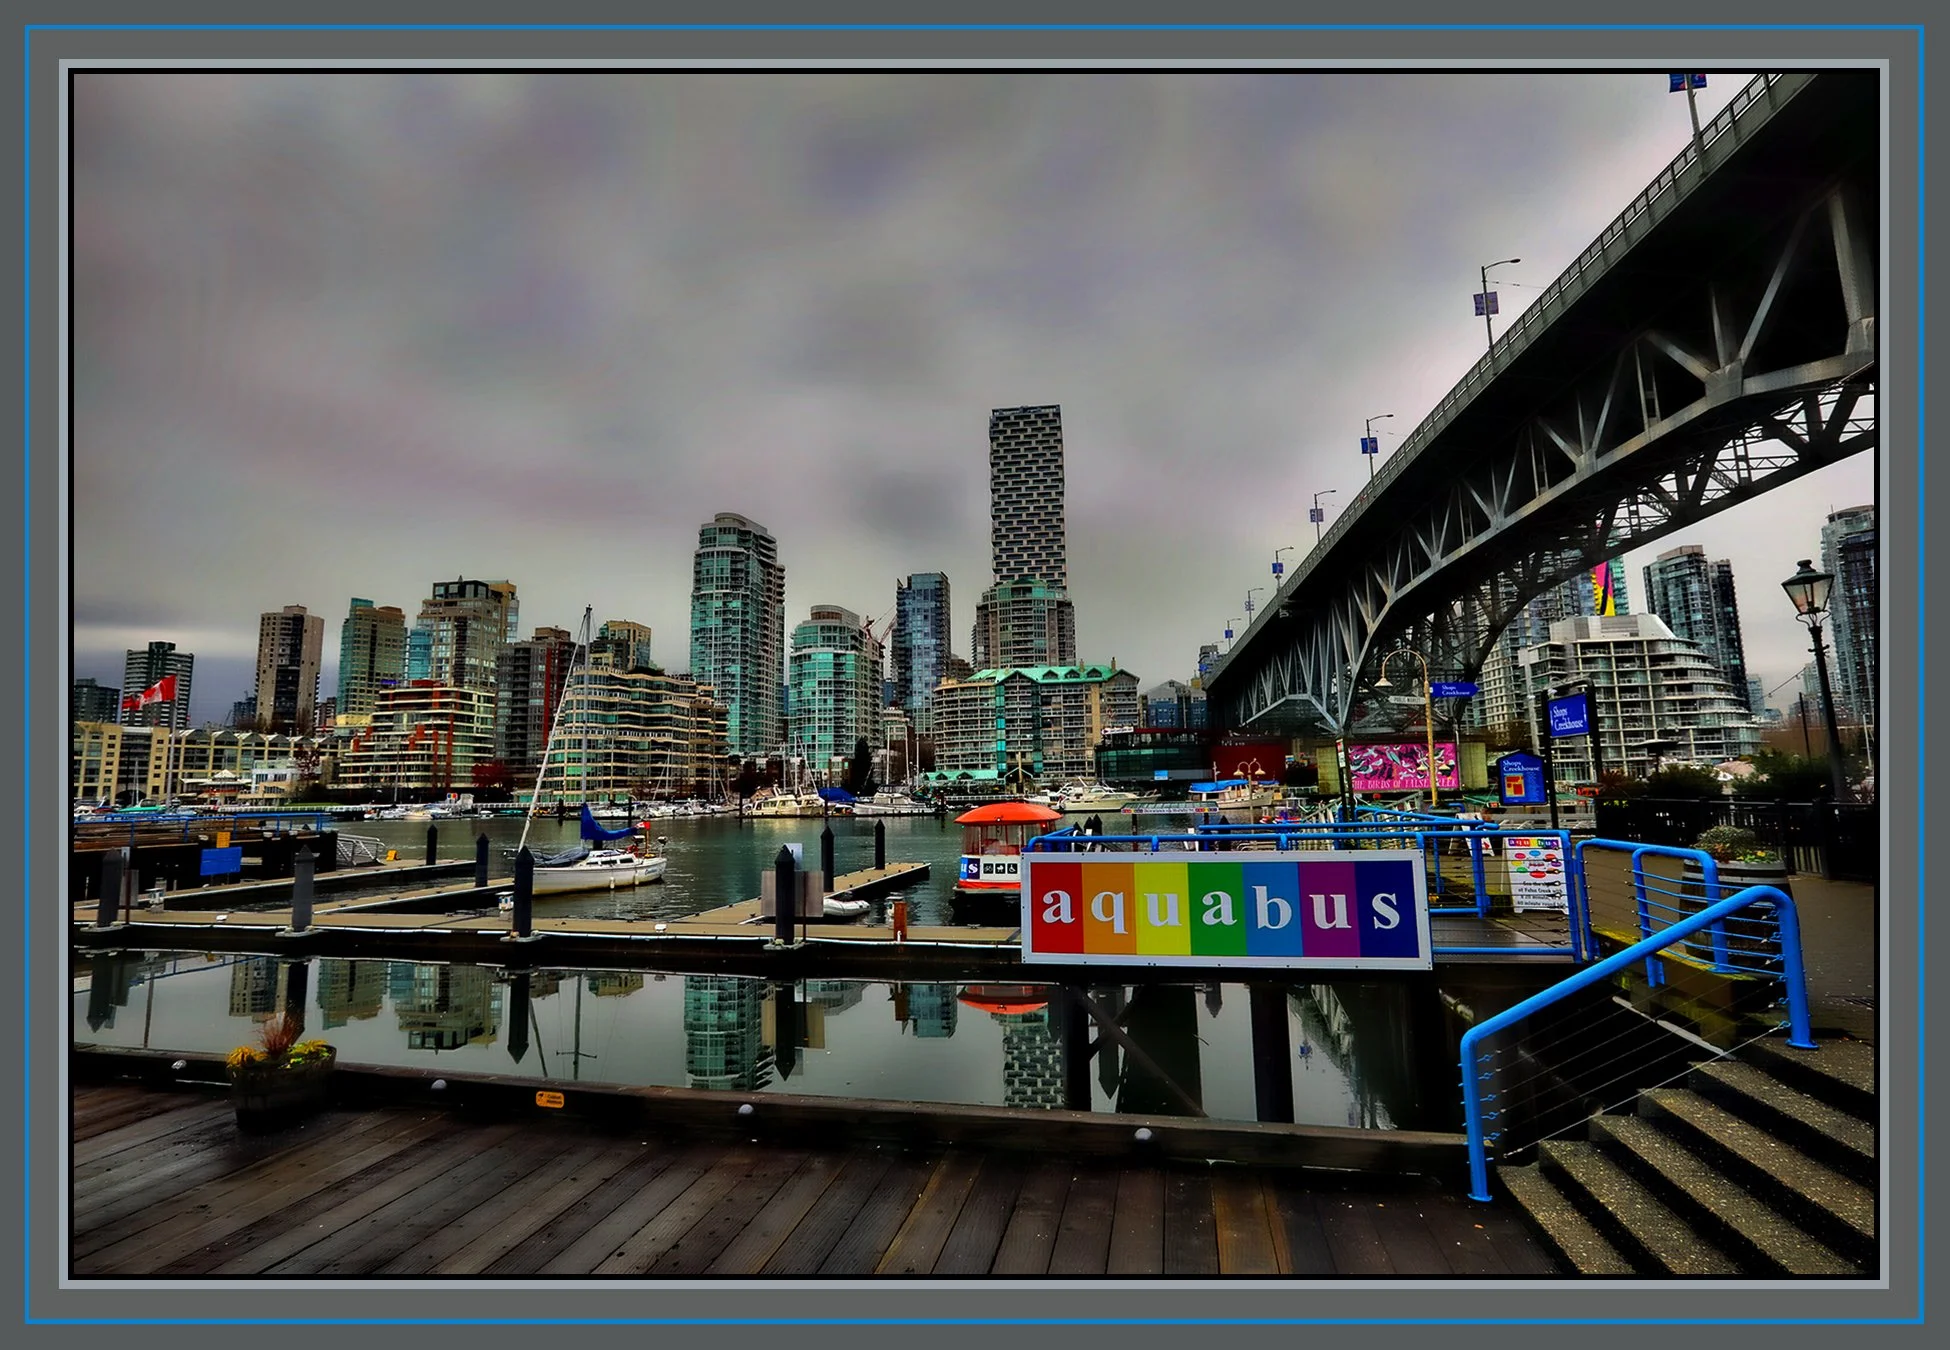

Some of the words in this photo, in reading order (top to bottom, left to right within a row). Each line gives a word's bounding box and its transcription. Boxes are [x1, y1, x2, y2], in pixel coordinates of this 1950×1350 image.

[1552, 705, 1568, 720] Shops
[1554, 717, 1584, 731] Creekhouse
[1367, 779, 1391, 789] BIRDS
[1405, 778, 1430, 788] FALSE
[1042, 885, 1400, 935] aquabus
